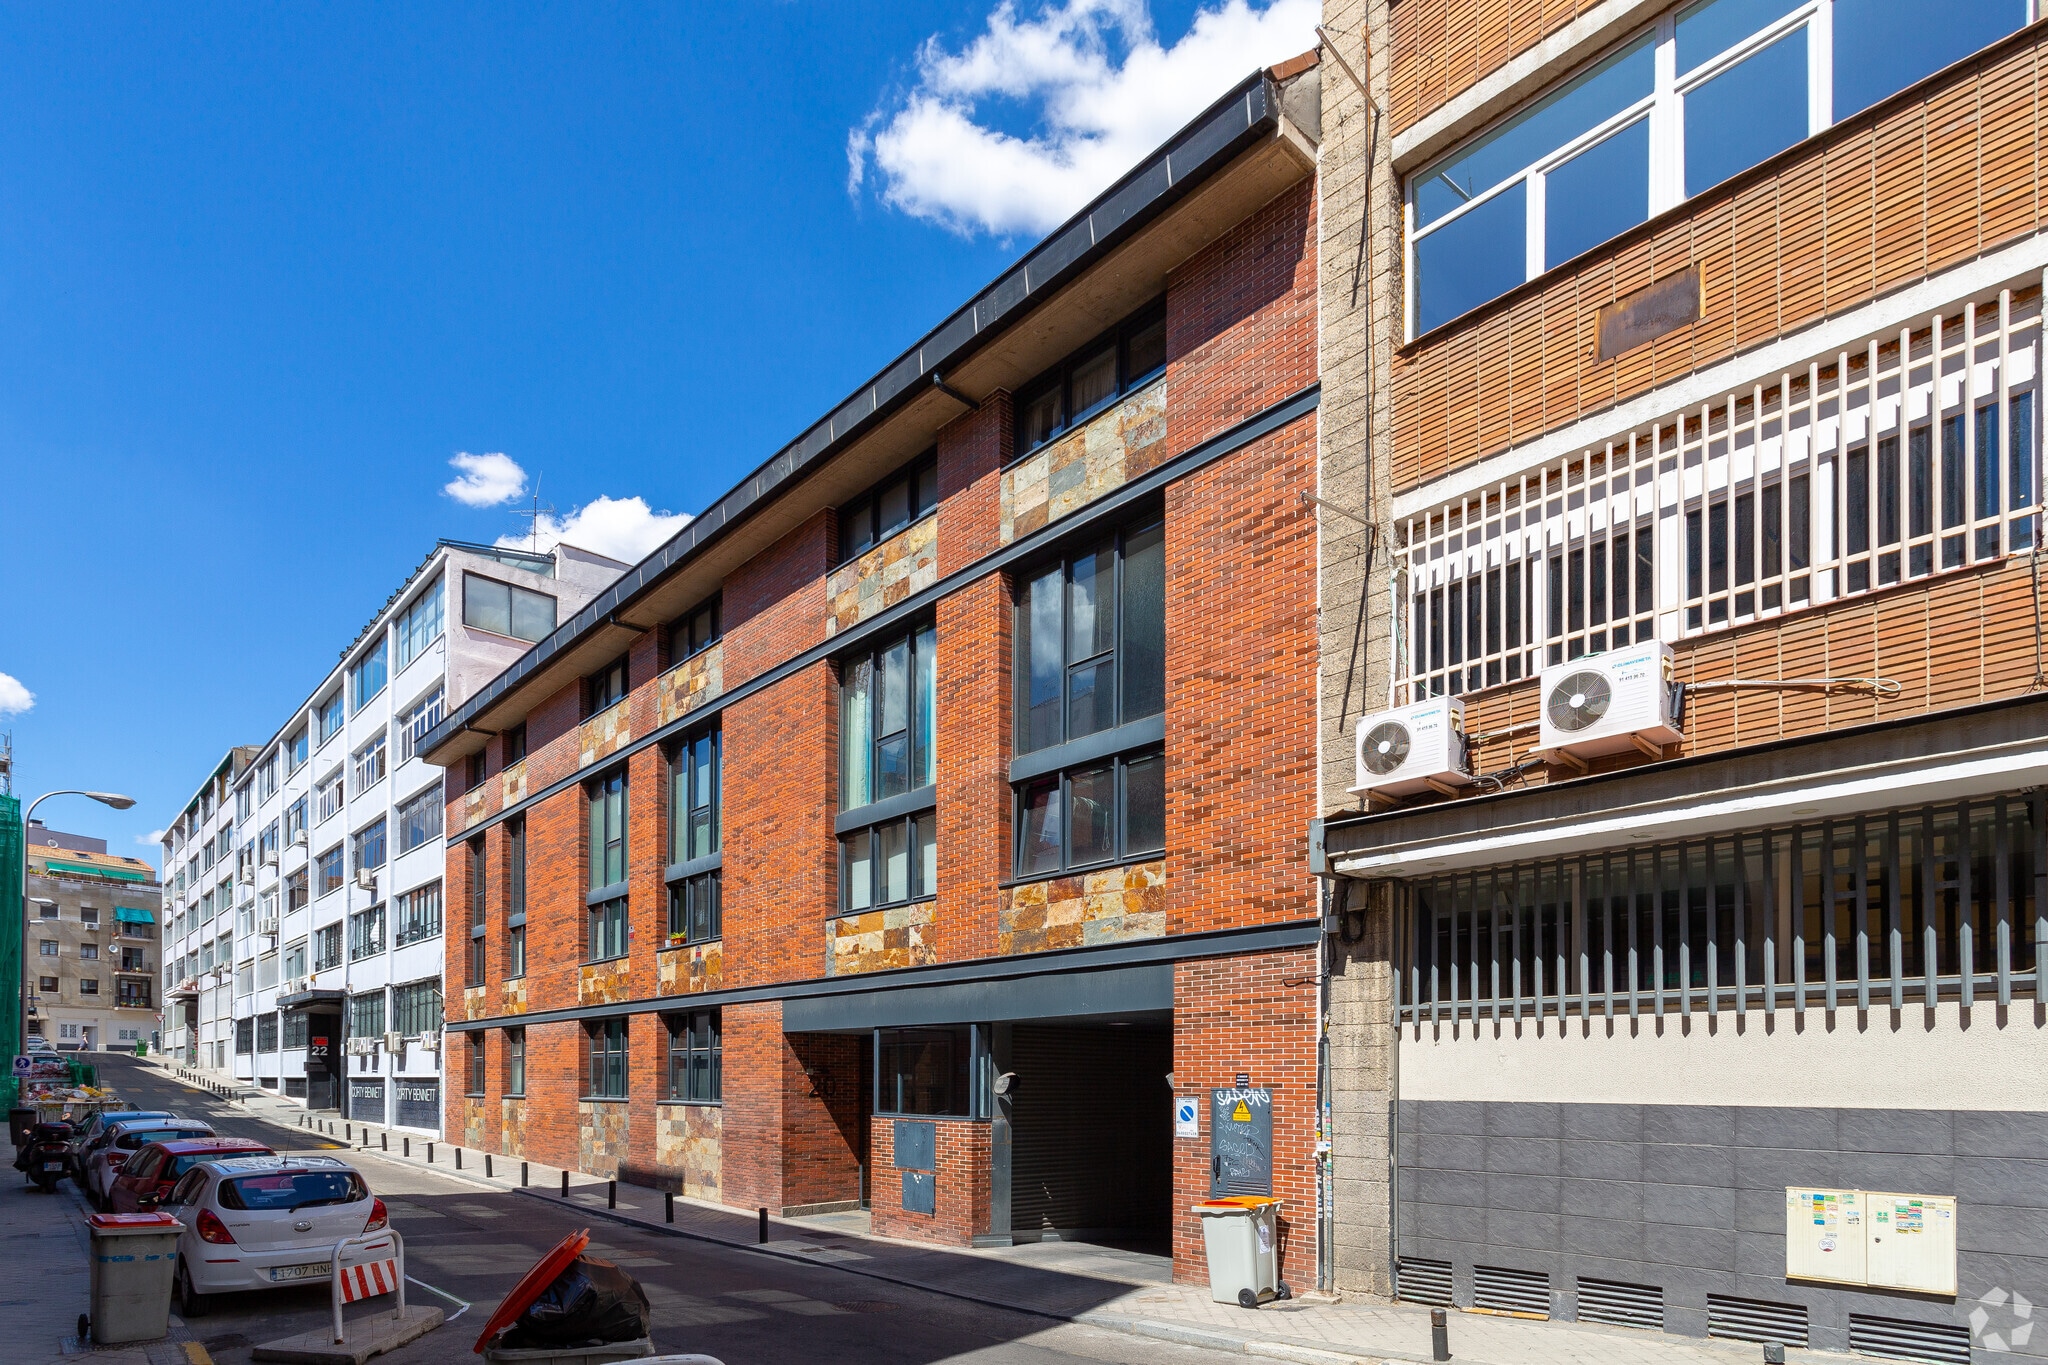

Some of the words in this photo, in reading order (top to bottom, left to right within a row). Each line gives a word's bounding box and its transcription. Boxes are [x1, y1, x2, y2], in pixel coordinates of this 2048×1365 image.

[312, 1046, 328, 1056] 22
[365, 1086, 383, 1099] BENNETT
[413, 1088, 436, 1102] BENNETT
